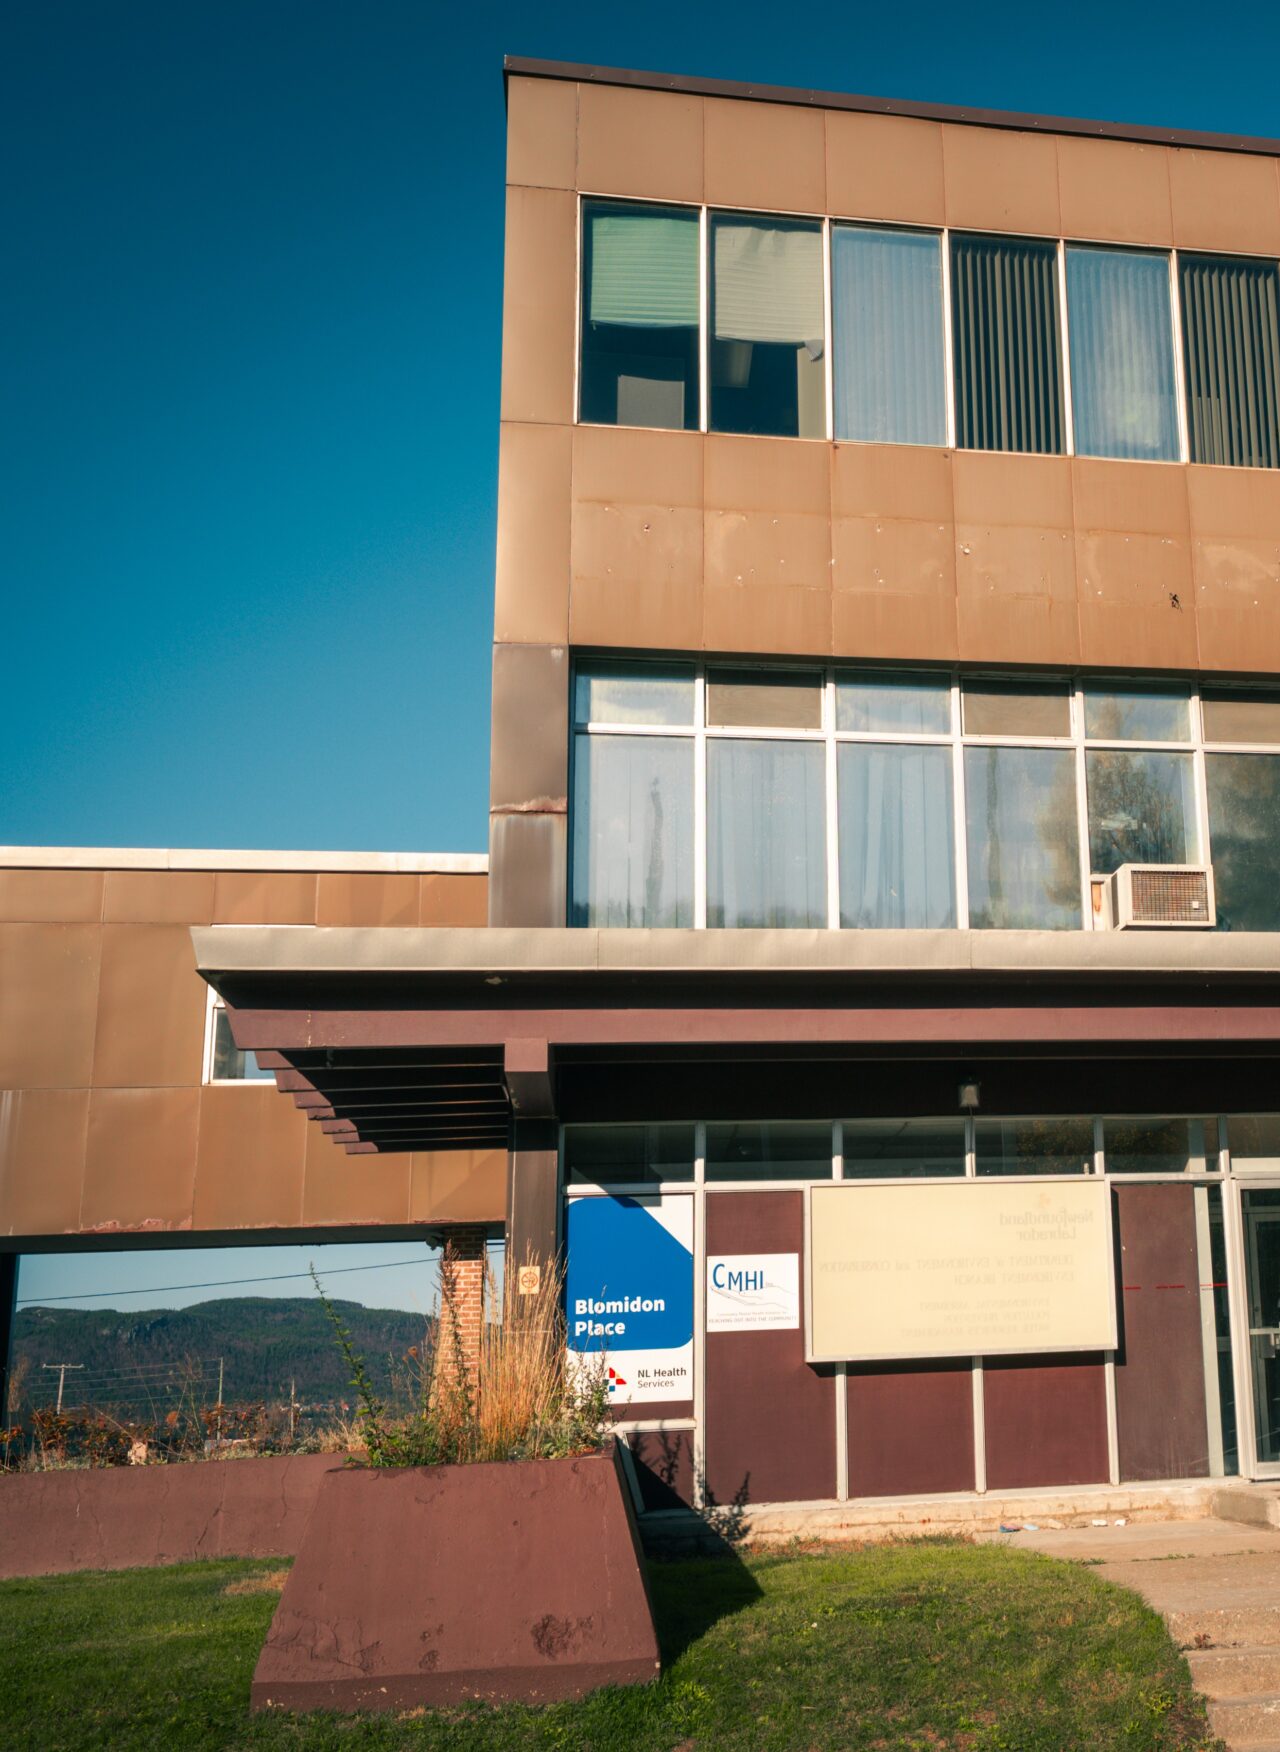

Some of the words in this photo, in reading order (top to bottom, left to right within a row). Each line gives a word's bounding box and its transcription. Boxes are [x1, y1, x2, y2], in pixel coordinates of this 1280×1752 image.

[712, 1263, 764, 1292] CMHI
[575, 1296, 666, 1315] Blomidon
[575, 1319, 626, 1337] Place
[637, 1369, 651, 1379] NL
[653, 1367, 687, 1378] Health
[637, 1379, 675, 1389] Services
